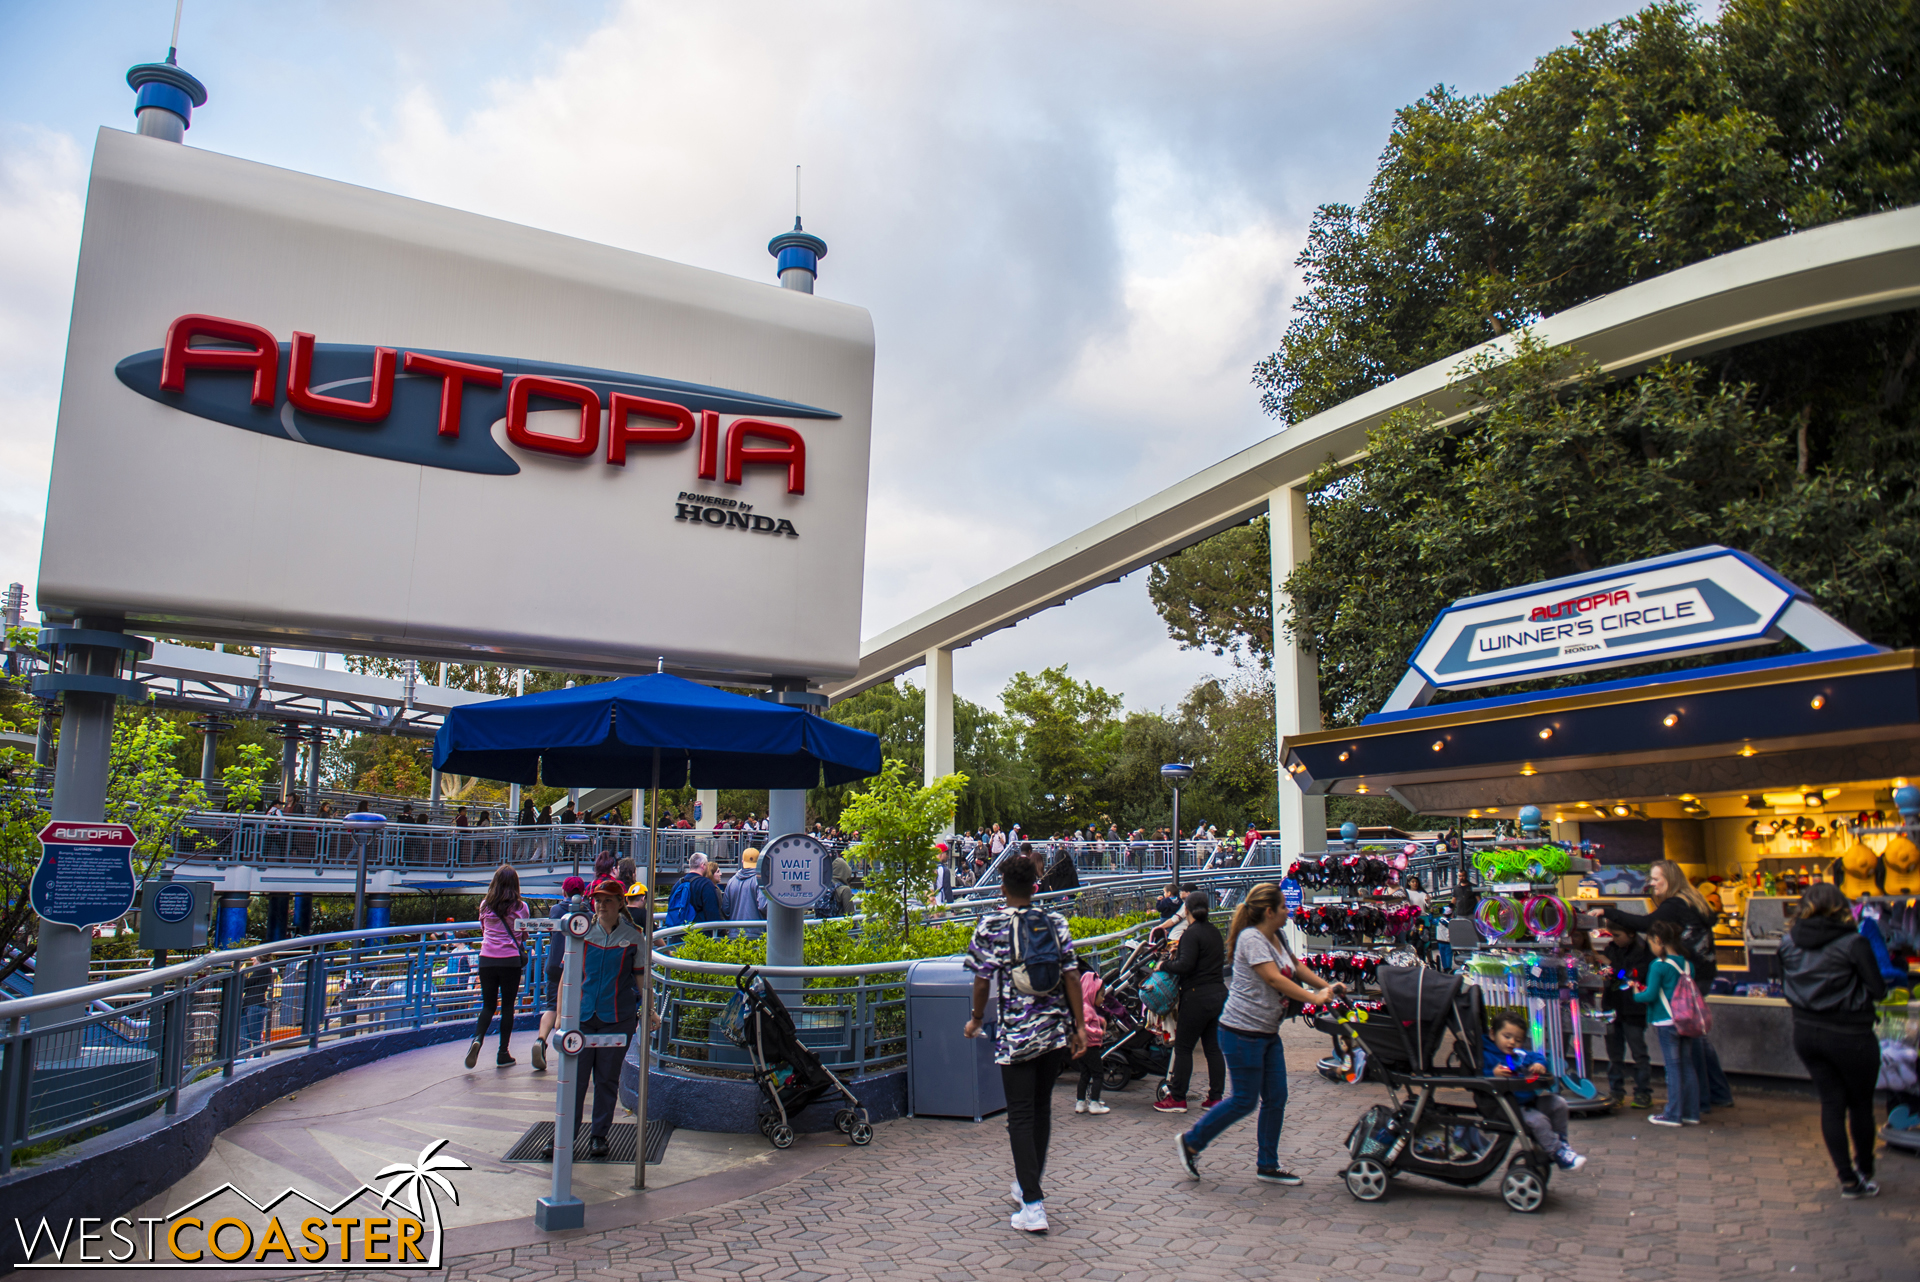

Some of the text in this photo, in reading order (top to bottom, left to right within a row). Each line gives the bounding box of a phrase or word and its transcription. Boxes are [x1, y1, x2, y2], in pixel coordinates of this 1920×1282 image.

[160, 313, 806, 496] AUTOPIA
[677, 491, 753, 512] POWERED by
[674, 502, 800, 538] HONDA
[1531, 590, 1630, 621] AUTOPIA
[1479, 600, 1696, 652] WINNER'S CIRCLE
[1564, 644, 1602, 654] HONDA
[55, 828, 122, 840] AUTOPIA
[780, 859, 812, 869] WAIT
[781, 871, 811, 881] TIME
